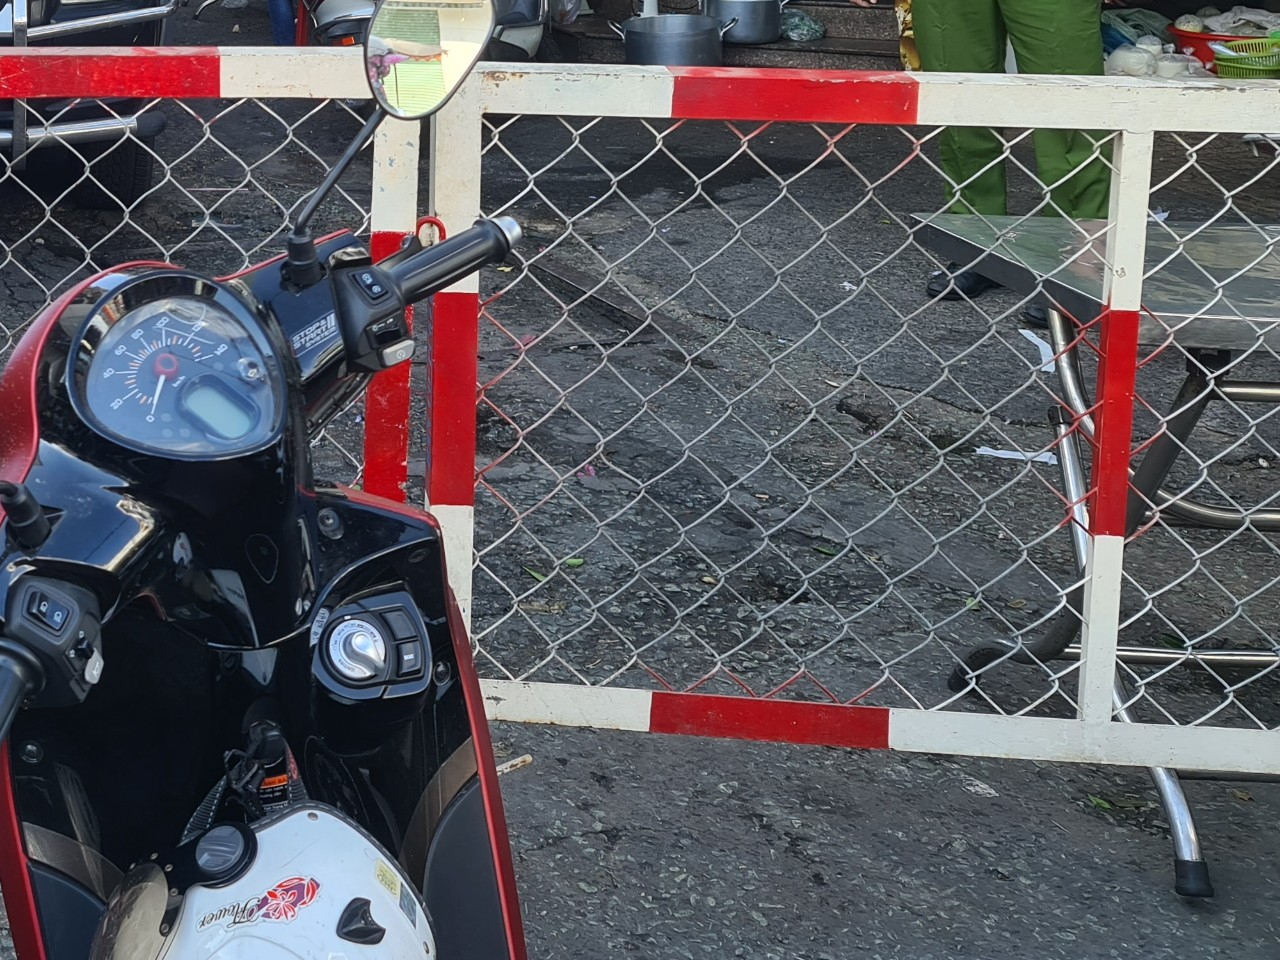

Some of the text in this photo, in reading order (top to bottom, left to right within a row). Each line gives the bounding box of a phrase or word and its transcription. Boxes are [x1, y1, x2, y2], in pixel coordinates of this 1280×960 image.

[155, 316, 170, 328] 100
[131, 328, 144, 340] 80
[293, 326, 328, 350] START
[305, 326, 337, 348] SYSTEM
[114, 344, 127, 356] 60
[214, 343, 228, 356] 140
[103, 368, 115, 379] 40
[110, 398, 123, 410] 20
[145, 415, 155, 423] 0
[199, 898, 261, 928] Flower
